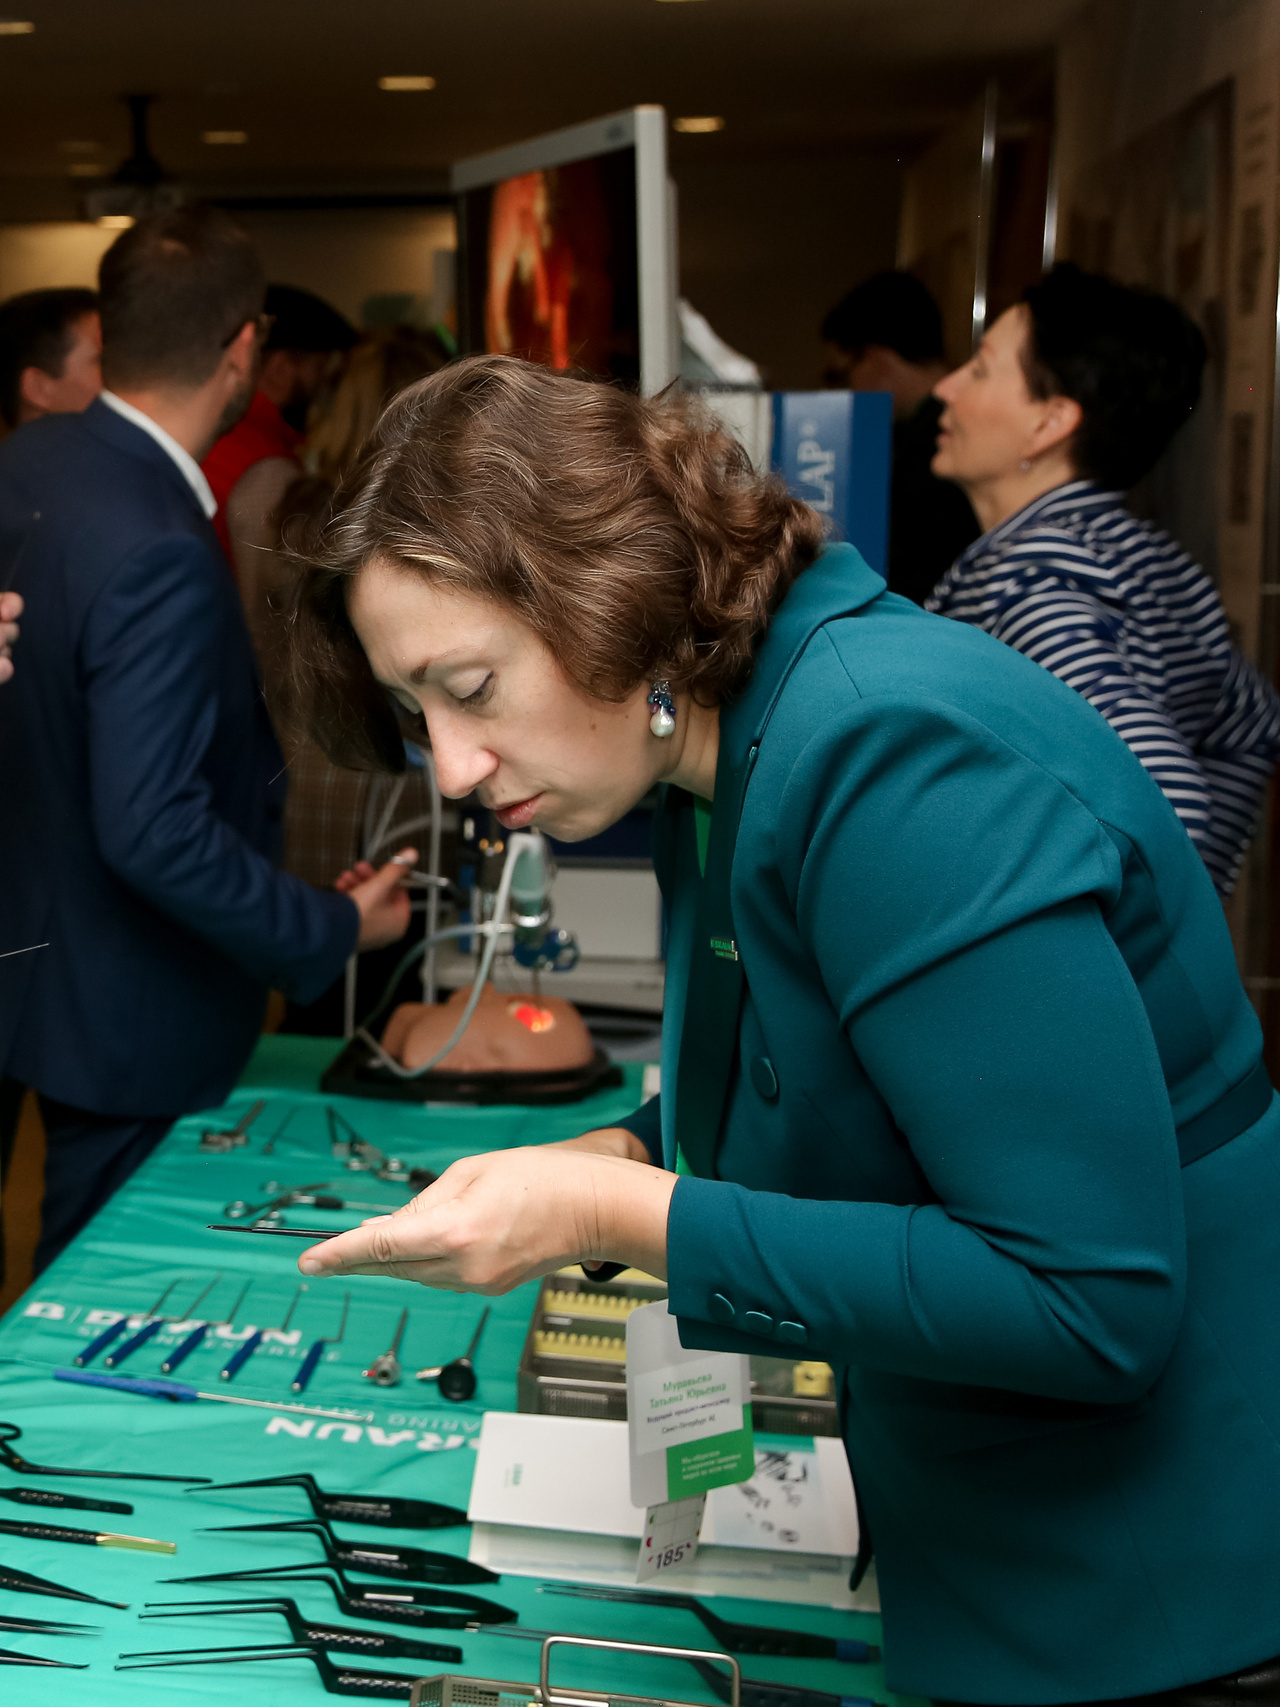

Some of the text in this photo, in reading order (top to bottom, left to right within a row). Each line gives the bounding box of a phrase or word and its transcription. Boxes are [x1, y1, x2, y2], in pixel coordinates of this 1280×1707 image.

[649, 1382, 727, 1409] Татьяна Юрьевна
[264, 1416, 482, 1451] RAUN
[656, 1544, 686, 1570] 185
